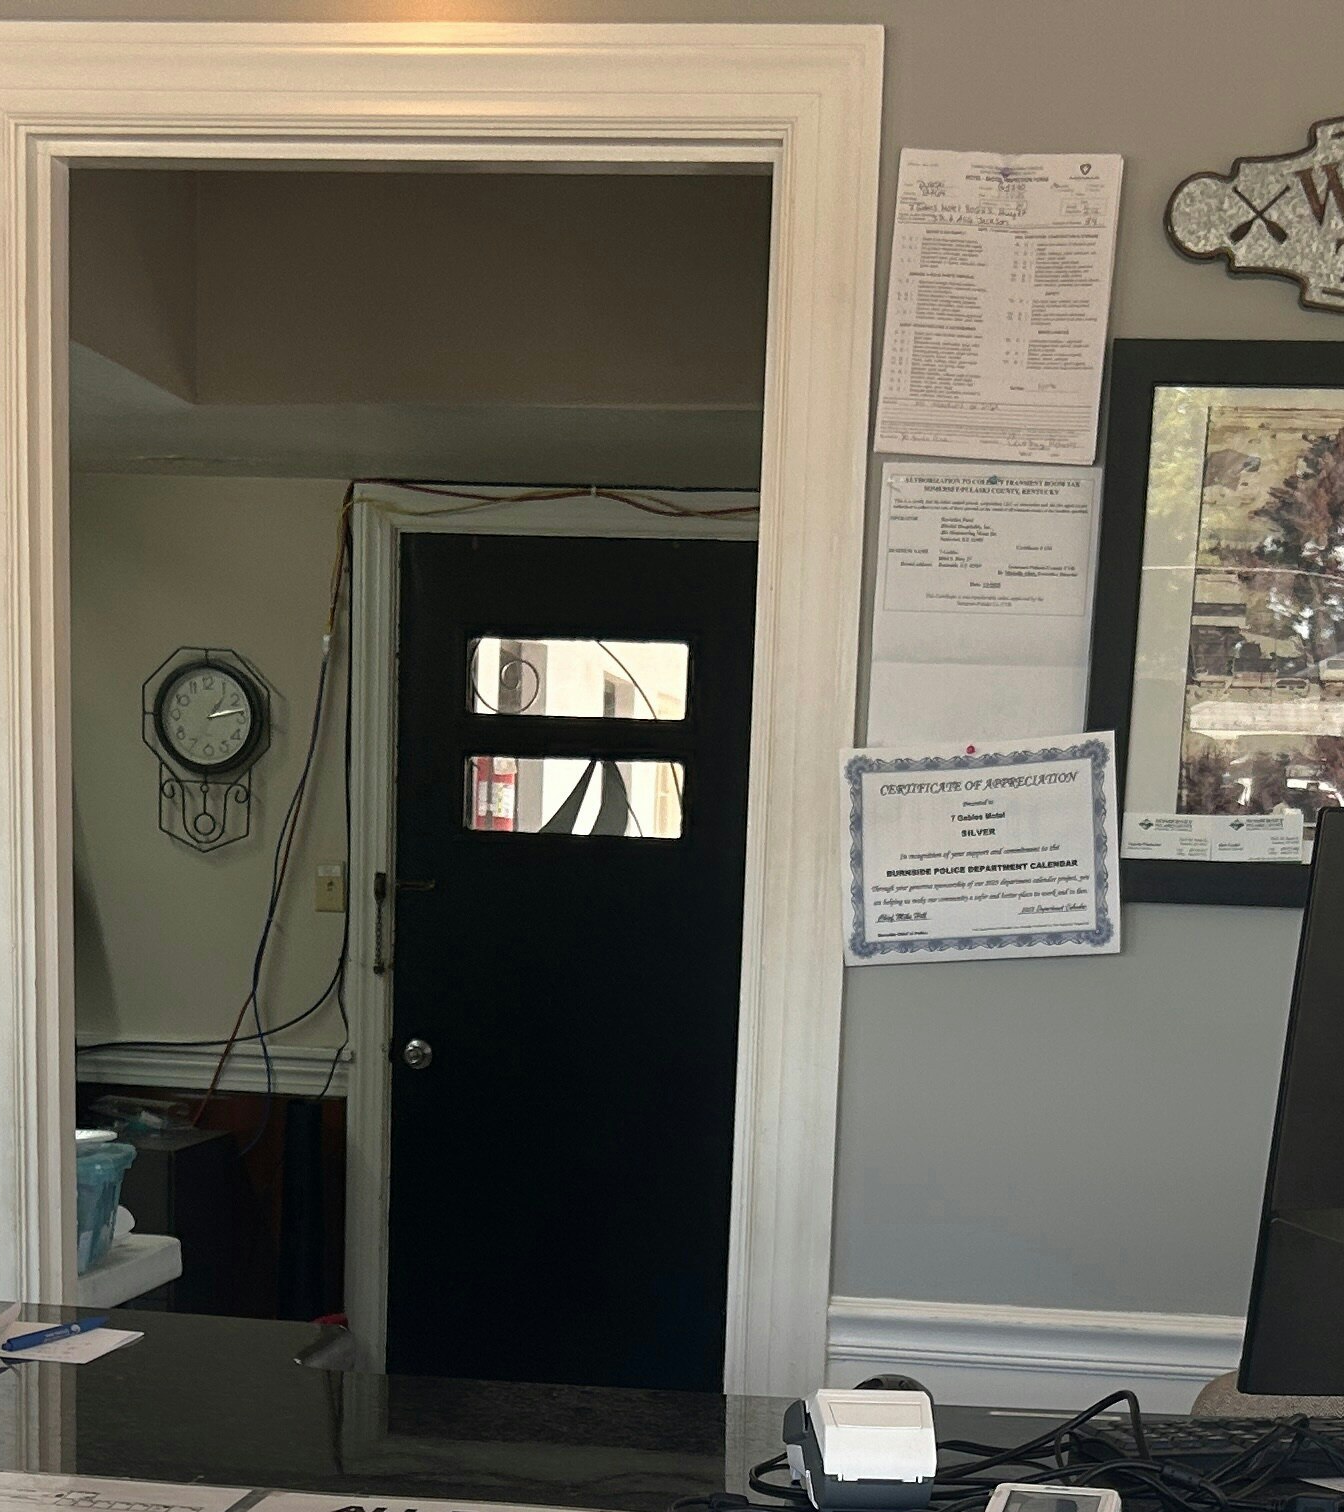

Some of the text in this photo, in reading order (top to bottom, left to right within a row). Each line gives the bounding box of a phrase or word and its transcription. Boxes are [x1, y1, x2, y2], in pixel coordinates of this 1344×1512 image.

[202, 674, 214, 690] 12
[230, 693, 240, 706] 2
[230, 729, 240, 740] 4
[880, 771, 1078, 796] CERTIFICATE OF APPRECIATION
[961, 828, 995, 837] SILVER
[886, 859, 1078, 877] BURNSIDE POLICE DEPARTMENT CALENDAR
